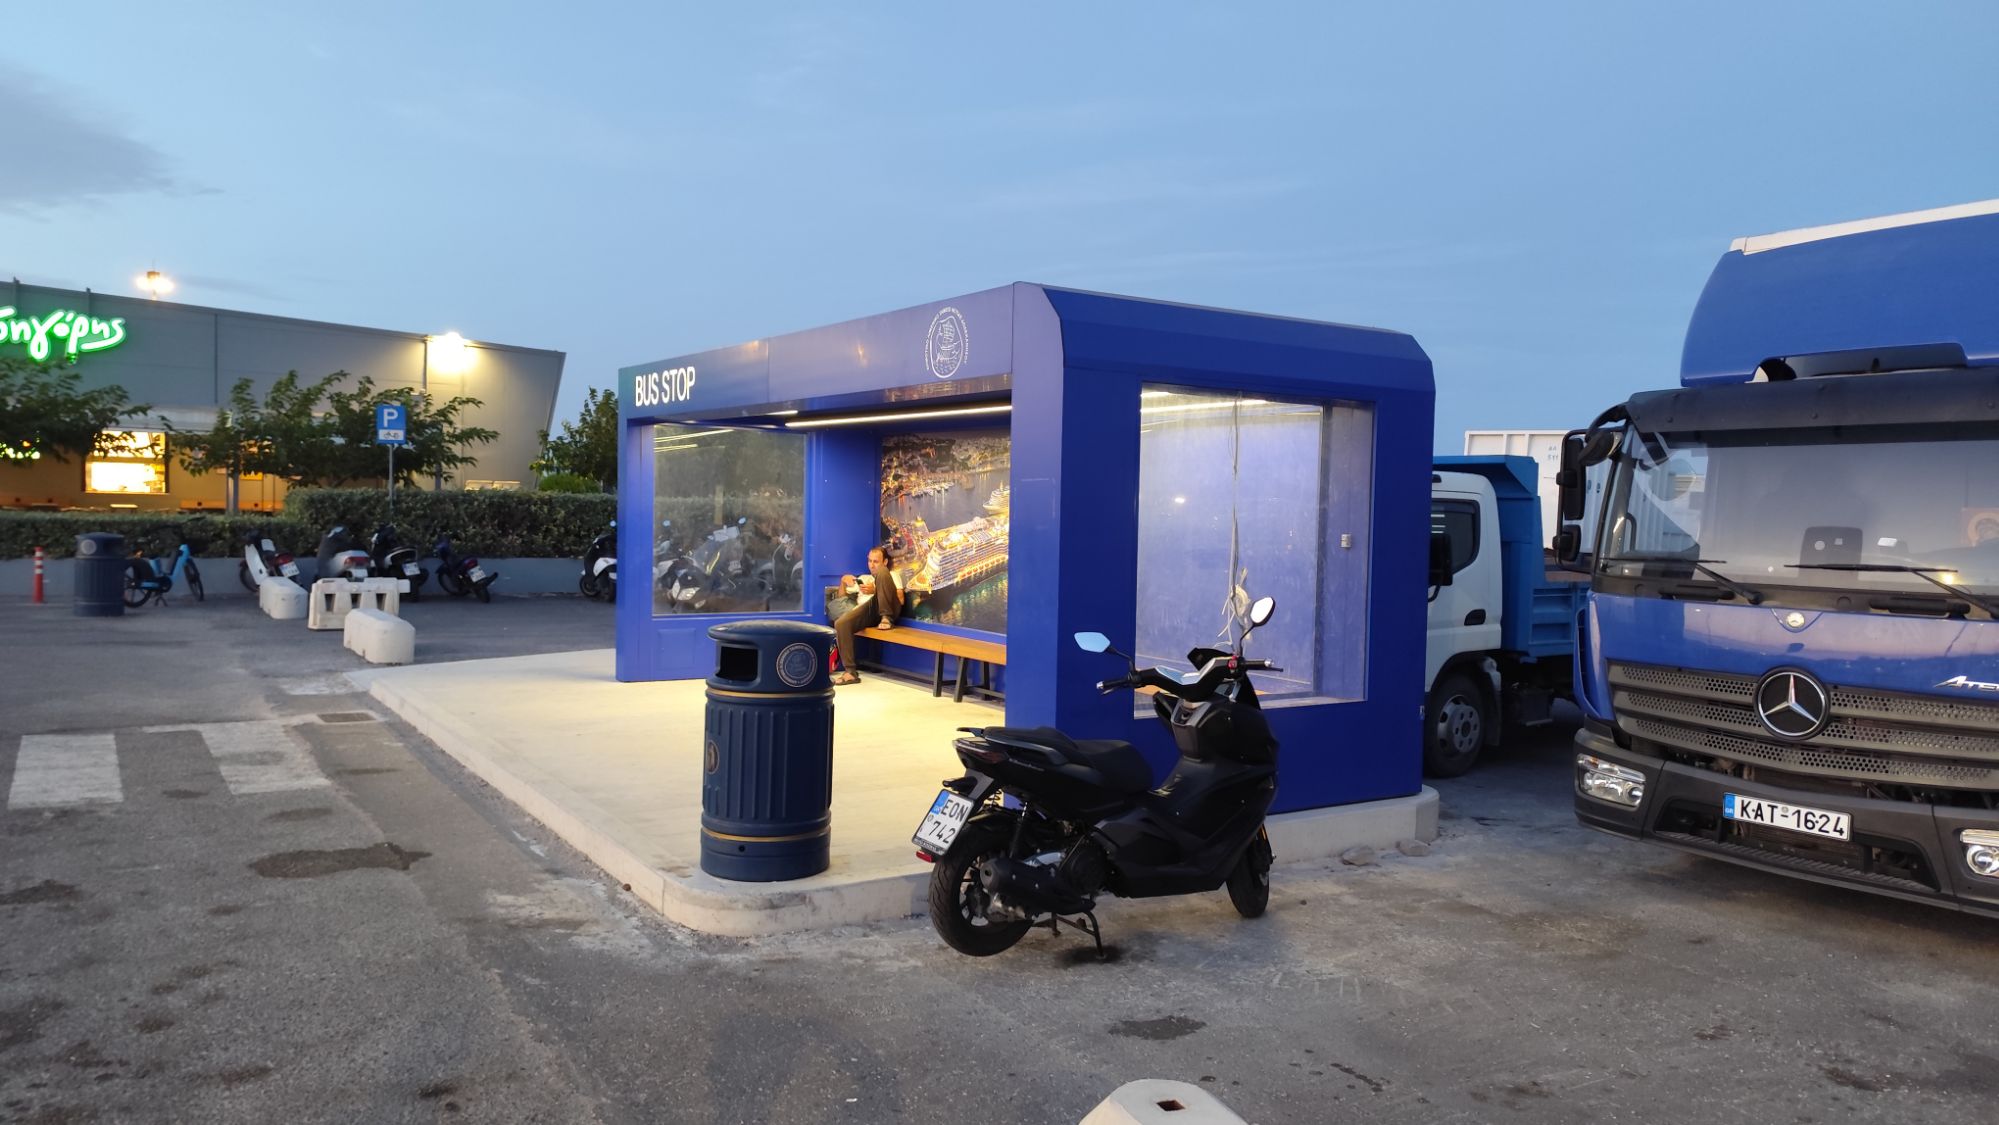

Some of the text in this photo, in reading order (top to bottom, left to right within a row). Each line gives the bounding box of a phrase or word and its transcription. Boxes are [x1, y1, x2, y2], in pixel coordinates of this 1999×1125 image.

[635, 366, 696, 407] BUS STOP
[383, 408, 398, 428] P
[1934, 675, 1999, 692] ATE
[940, 799, 969, 823] EON
[928, 820, 956, 844] 742
